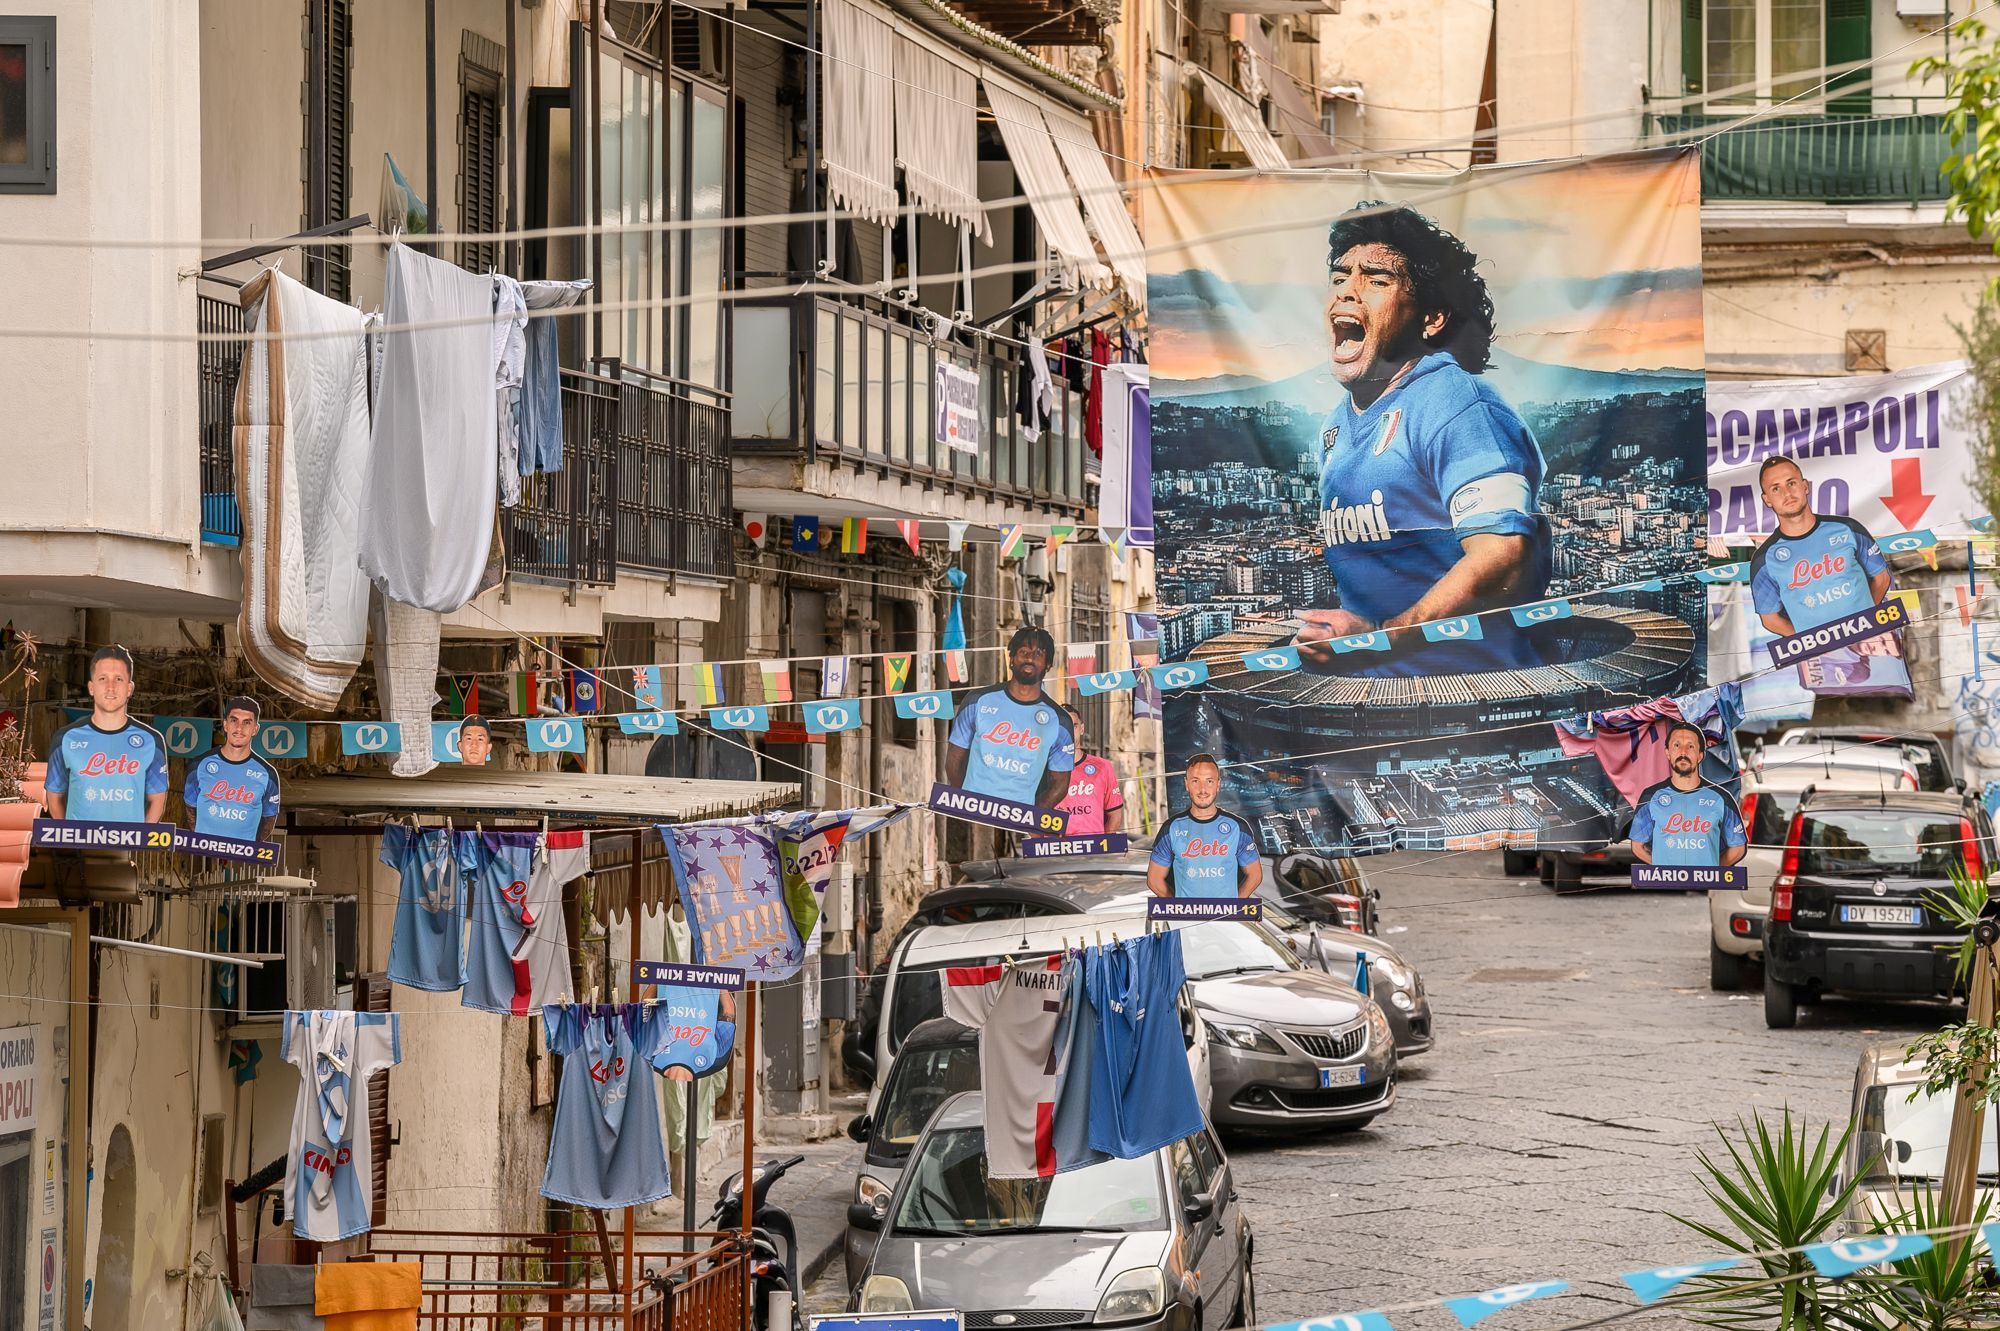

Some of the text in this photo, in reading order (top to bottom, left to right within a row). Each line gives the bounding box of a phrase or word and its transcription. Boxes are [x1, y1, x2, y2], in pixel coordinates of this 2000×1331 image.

[1829, 534, 1849, 547] EA7
[1787, 553, 1846, 590] Lete
[1816, 582, 1853, 605] MSC
[1774, 605, 1902, 660] LOBOTKA 68
[980, 705, 999, 715] EA7
[70, 741, 89, 749] EA7
[981, 721, 1042, 751] Lete
[79, 752, 139, 777] Lete
[995, 756, 1031, 775] MSC
[246, 769, 263, 779] EA7
[99, 789, 134, 801] MSC
[204, 779, 255, 804] Lete
[1068, 780, 1095, 797] ete
[936, 791, 1063, 832] ANGUISSA 99
[1066, 805, 1092, 816] MSC
[1698, 798, 1716, 807] EA7
[219, 807, 248, 821] MSC
[1661, 812, 1712, 834] Lete
[41, 826, 171, 847] ZIELIŃSKI 20
[1677, 838, 1706, 850] MSC
[175, 835, 273, 860] DI LORENZO 22
[1034, 838, 1108, 856] MERET 1
[1181, 838, 1229, 859] Lete
[1199, 867, 1225, 878] MSC
[1638, 867, 1734, 883] MÁRIO RUI 6
[1152, 903, 1257, 915] A.RRAHMANI 13
[1850, 907, 1912, 922] DV 195ZH
[639, 966, 740, 985] MINJAE KIM 3
[669, 1006, 697, 1018] MSC
[670, 1024, 712, 1047] Let
[0, 1038, 35, 1070] ORARIO
